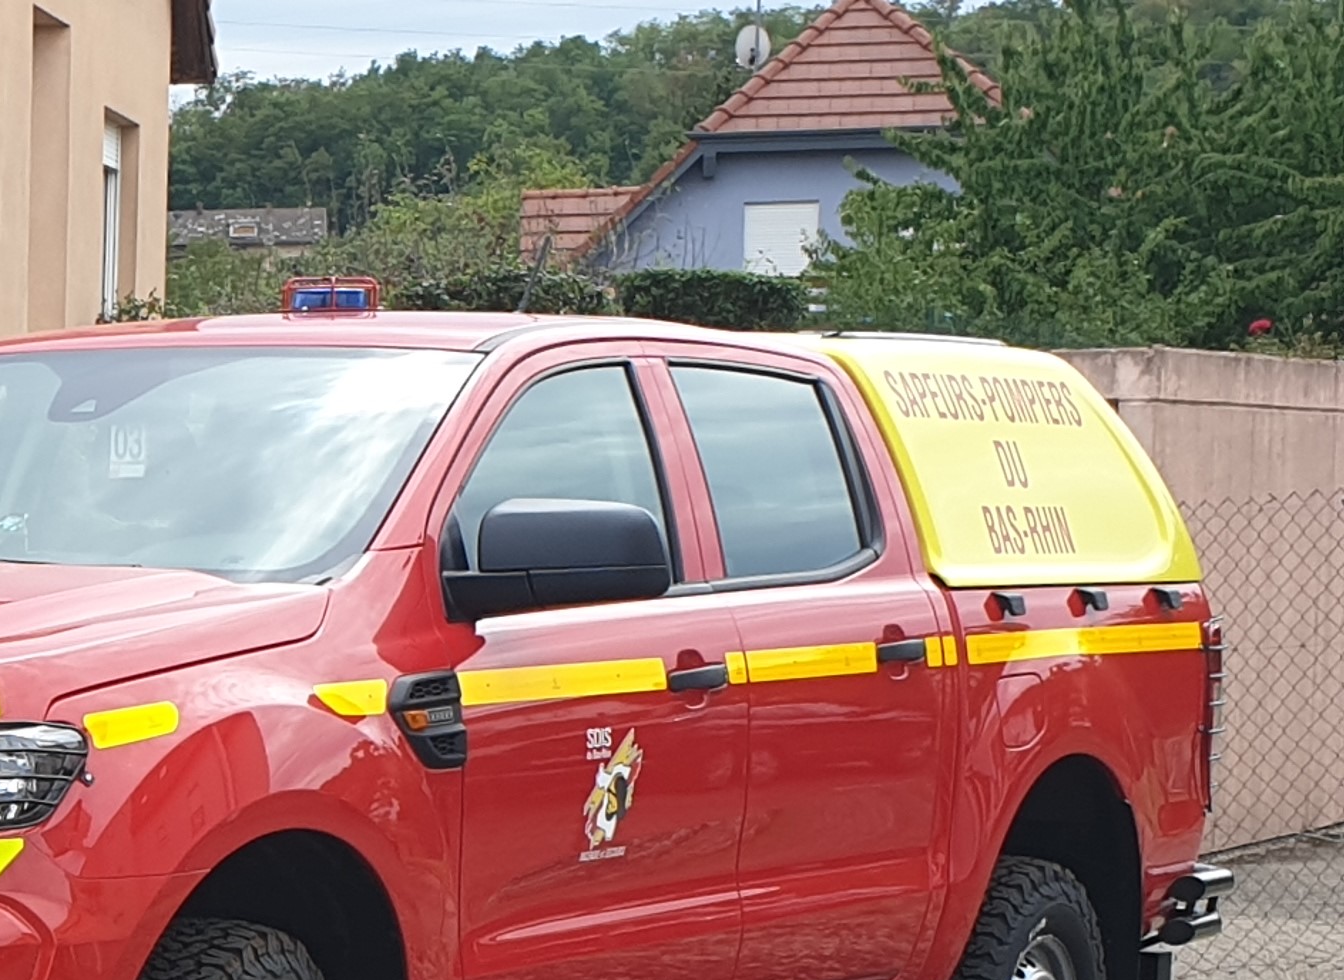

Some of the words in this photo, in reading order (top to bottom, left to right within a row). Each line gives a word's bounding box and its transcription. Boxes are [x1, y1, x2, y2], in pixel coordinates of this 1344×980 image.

[883, 370, 1082, 427] SAPEURS-POMPIERS
[993, 440, 1028, 489] DU
[981, 505, 1076, 554] BAS-RHIN
[586, 727, 612, 748] SDIS
